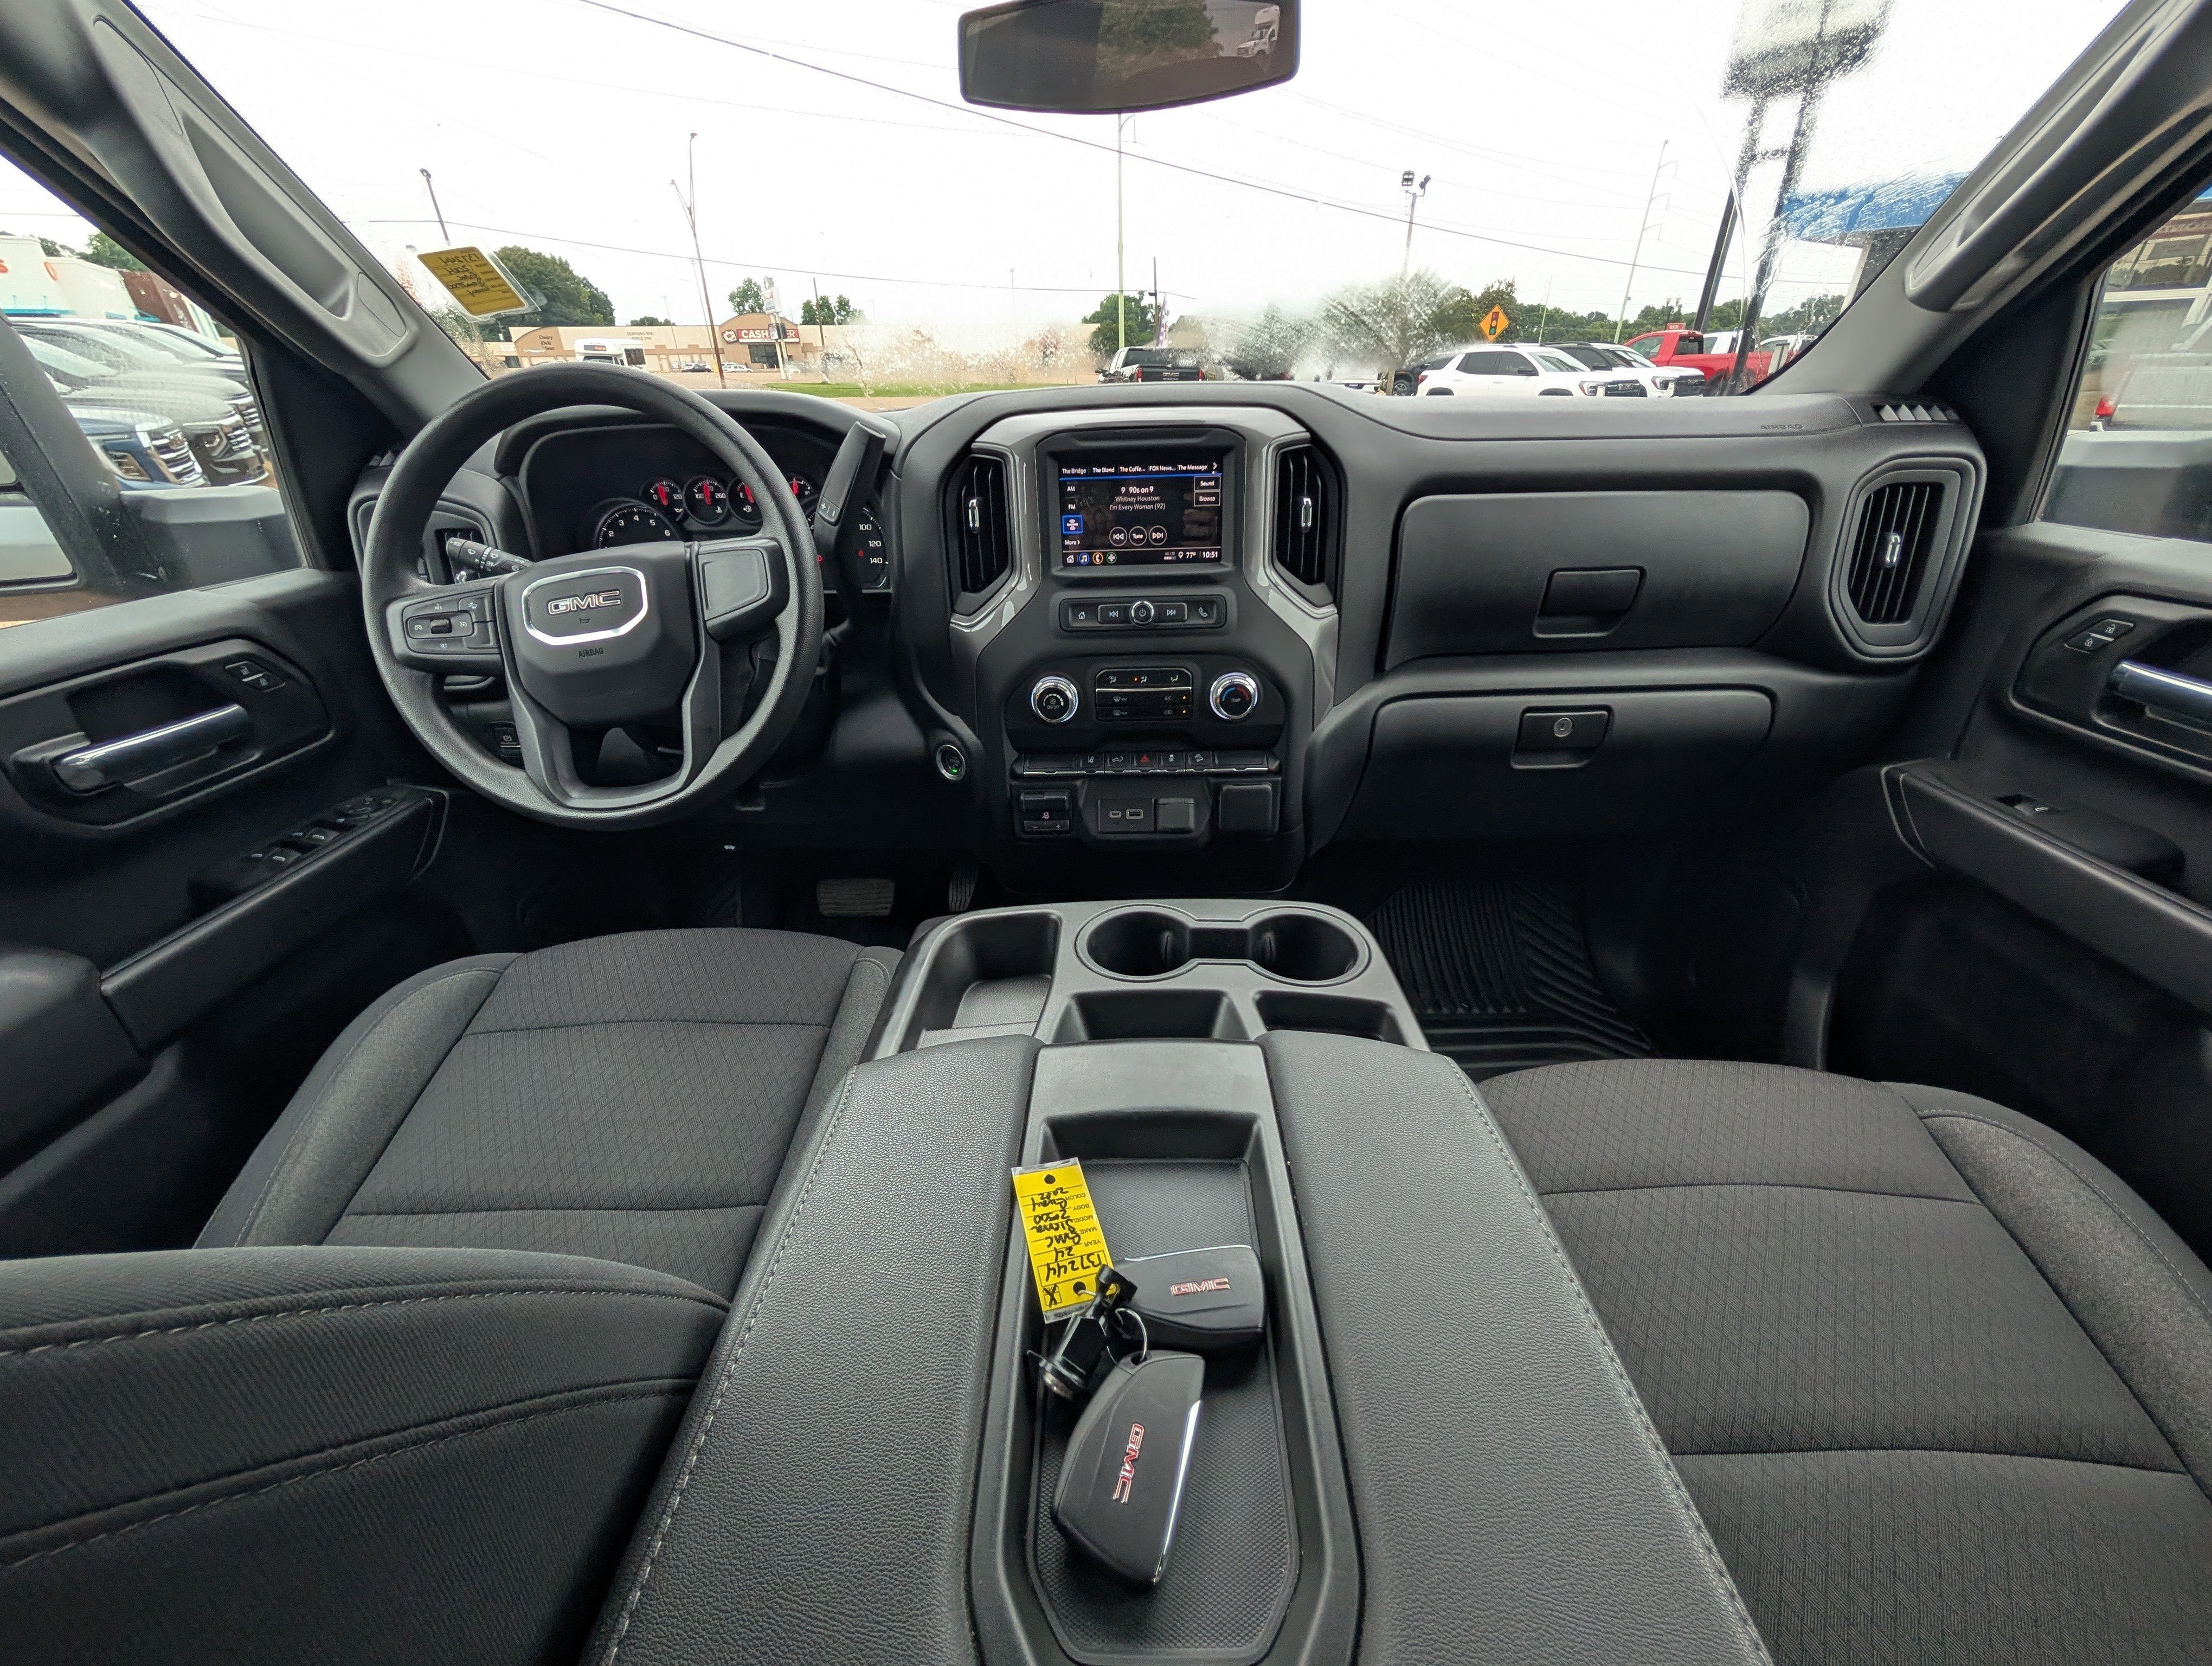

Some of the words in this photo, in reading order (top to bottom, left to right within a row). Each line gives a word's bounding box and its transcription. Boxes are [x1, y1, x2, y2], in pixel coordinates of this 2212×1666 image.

[741, 330, 769, 338] CASH
[548, 590, 621, 614] GMC
[578, 648, 604, 658] AIRBAG
[1065, 1193, 1086, 1201] COLOR
[1073, 1203, 1090, 1211] BODY
[1033, 1209, 1071, 1225] 2500
[1072, 1214, 1094, 1222] MODEL
[1079, 1226, 1097, 1234] MAKE
[1084, 1238, 1102, 1247] YEAR
[1053, 1246, 1075, 1262] 24
[1170, 1277, 1231, 1296] GMC
[1112, 1422, 1145, 1505] GMC
